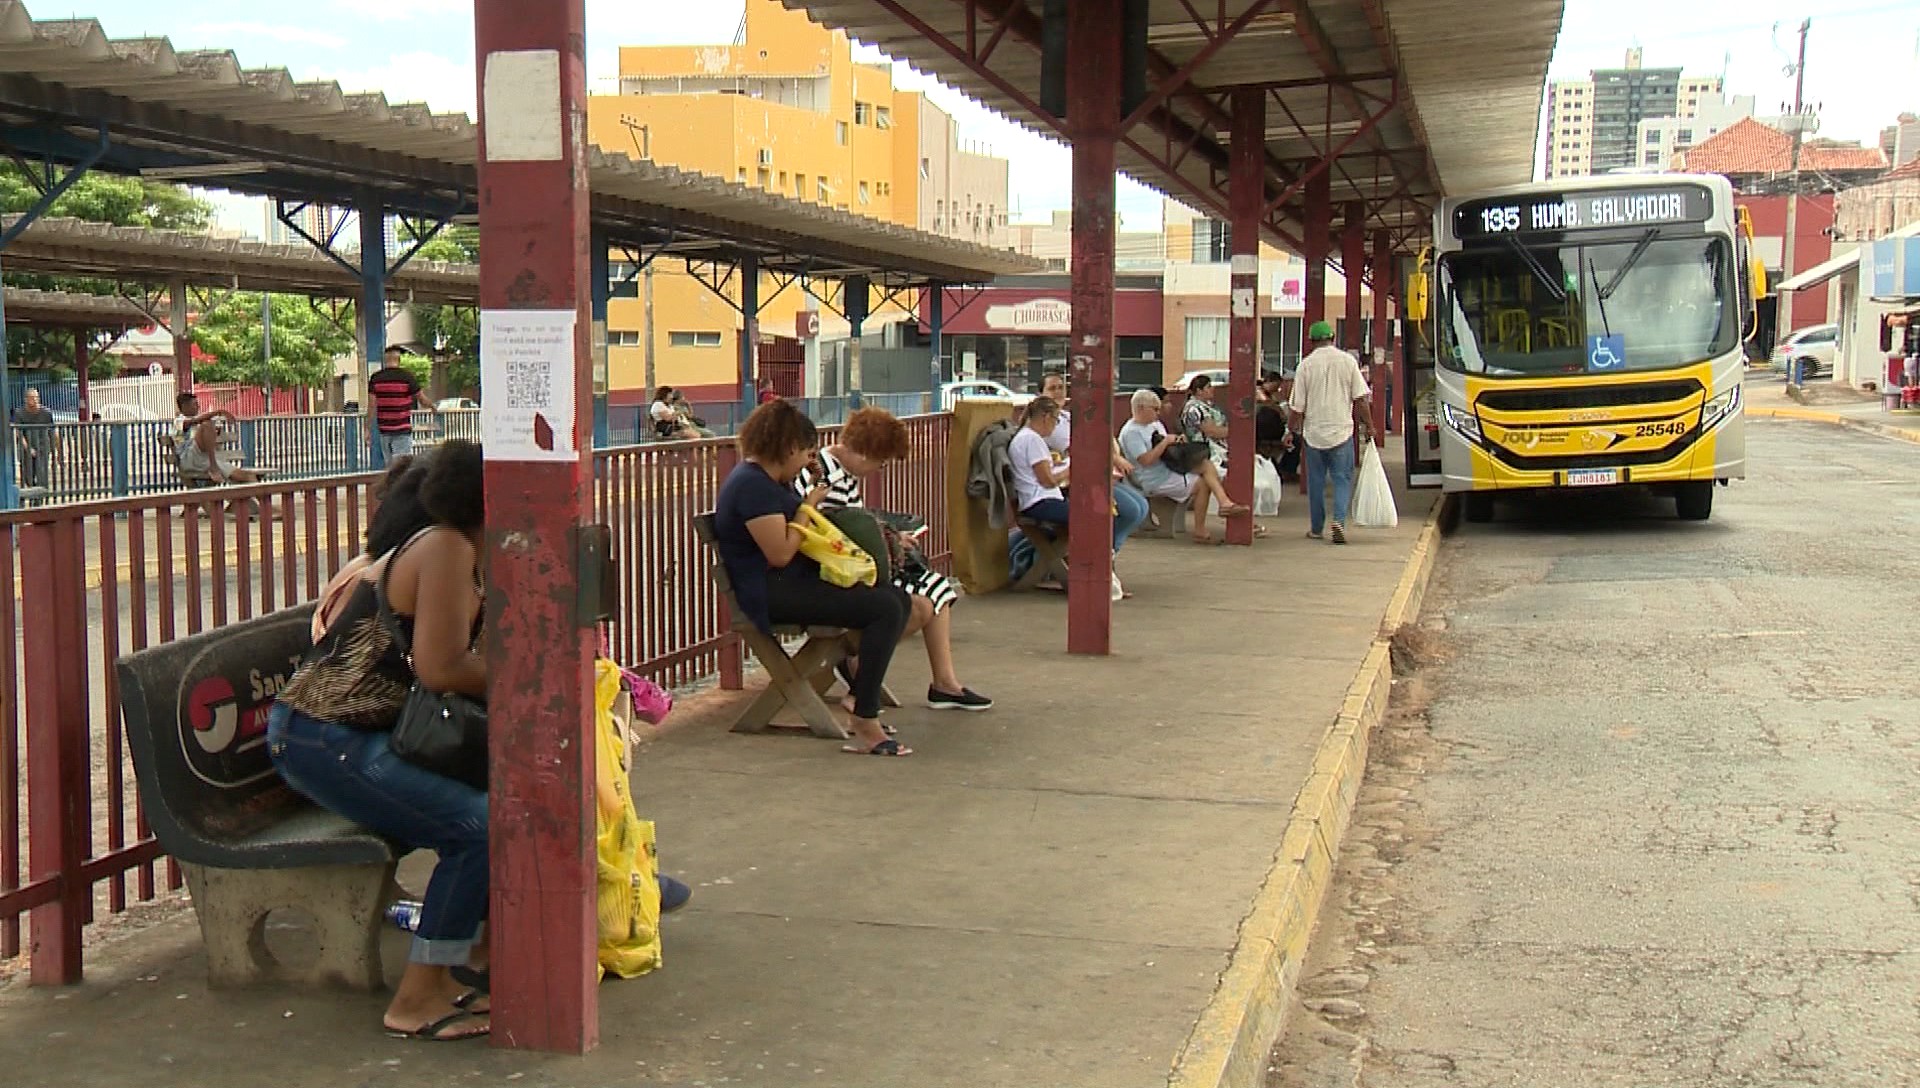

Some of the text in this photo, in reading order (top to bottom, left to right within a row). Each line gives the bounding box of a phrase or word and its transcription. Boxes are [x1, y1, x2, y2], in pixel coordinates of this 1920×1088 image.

[1481, 193, 1681, 233] 135 HUMB. SALVADOR
[1635, 422, 1685, 437] 25548
